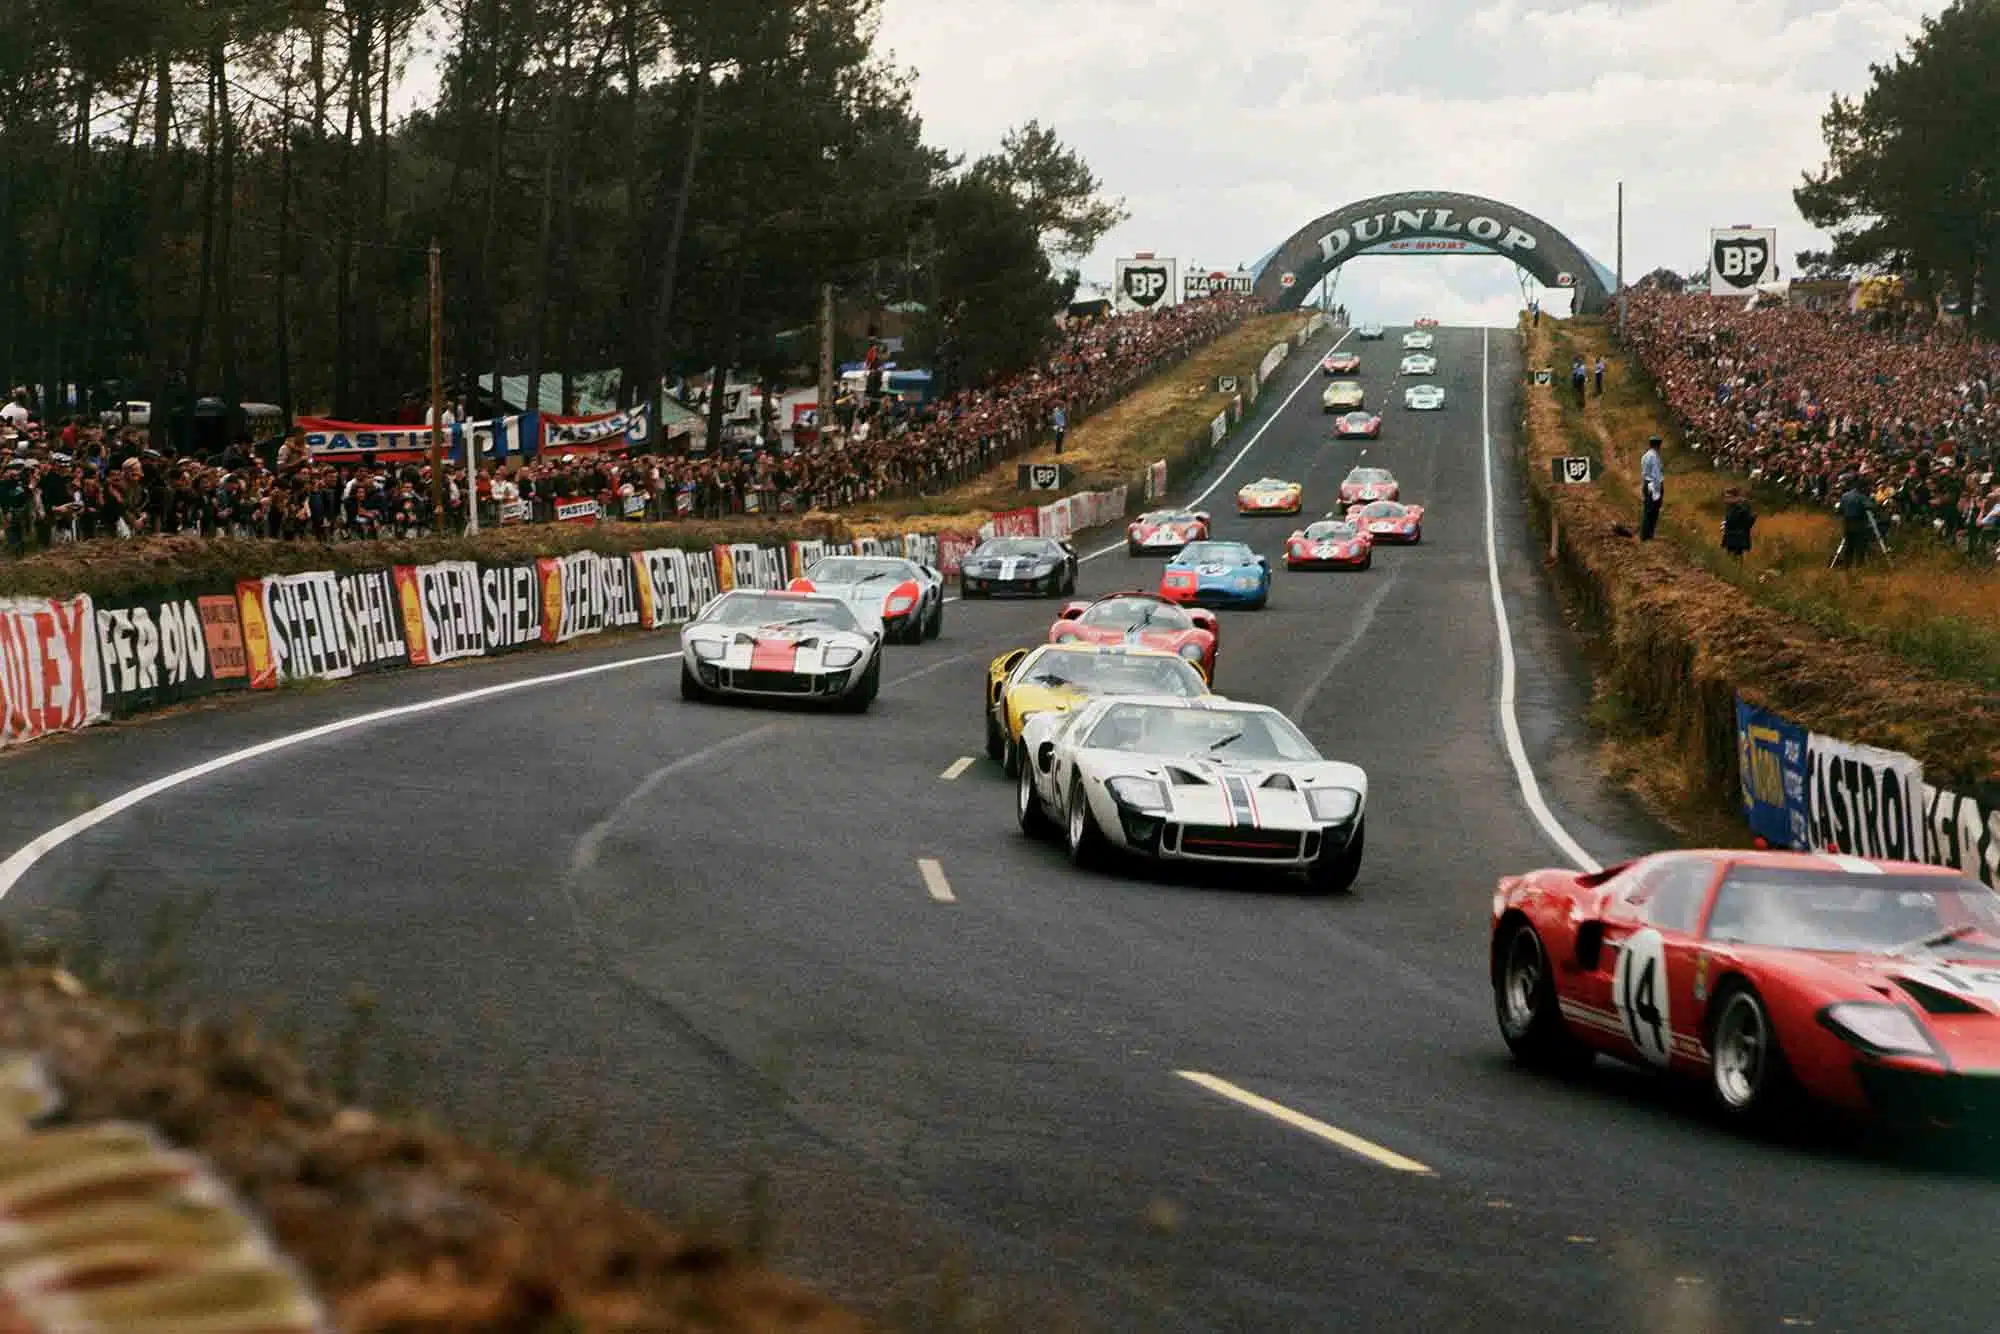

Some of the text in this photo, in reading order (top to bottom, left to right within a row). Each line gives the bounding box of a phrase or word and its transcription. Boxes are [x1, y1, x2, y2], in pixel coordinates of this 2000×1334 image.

[1317, 208, 1537, 263] DUNLOP
[1722, 246, 1764, 276] BP
[1130, 273, 1164, 297] BP
[1185, 277, 1251, 291] MARTINI
[1037, 470, 1054, 483] BP
[1569, 462, 1585, 476] BP
[268, 571, 405, 675] SHELL SHELL
[424, 570, 483, 656] SHELL
[1622, 948, 1664, 1053] 14
